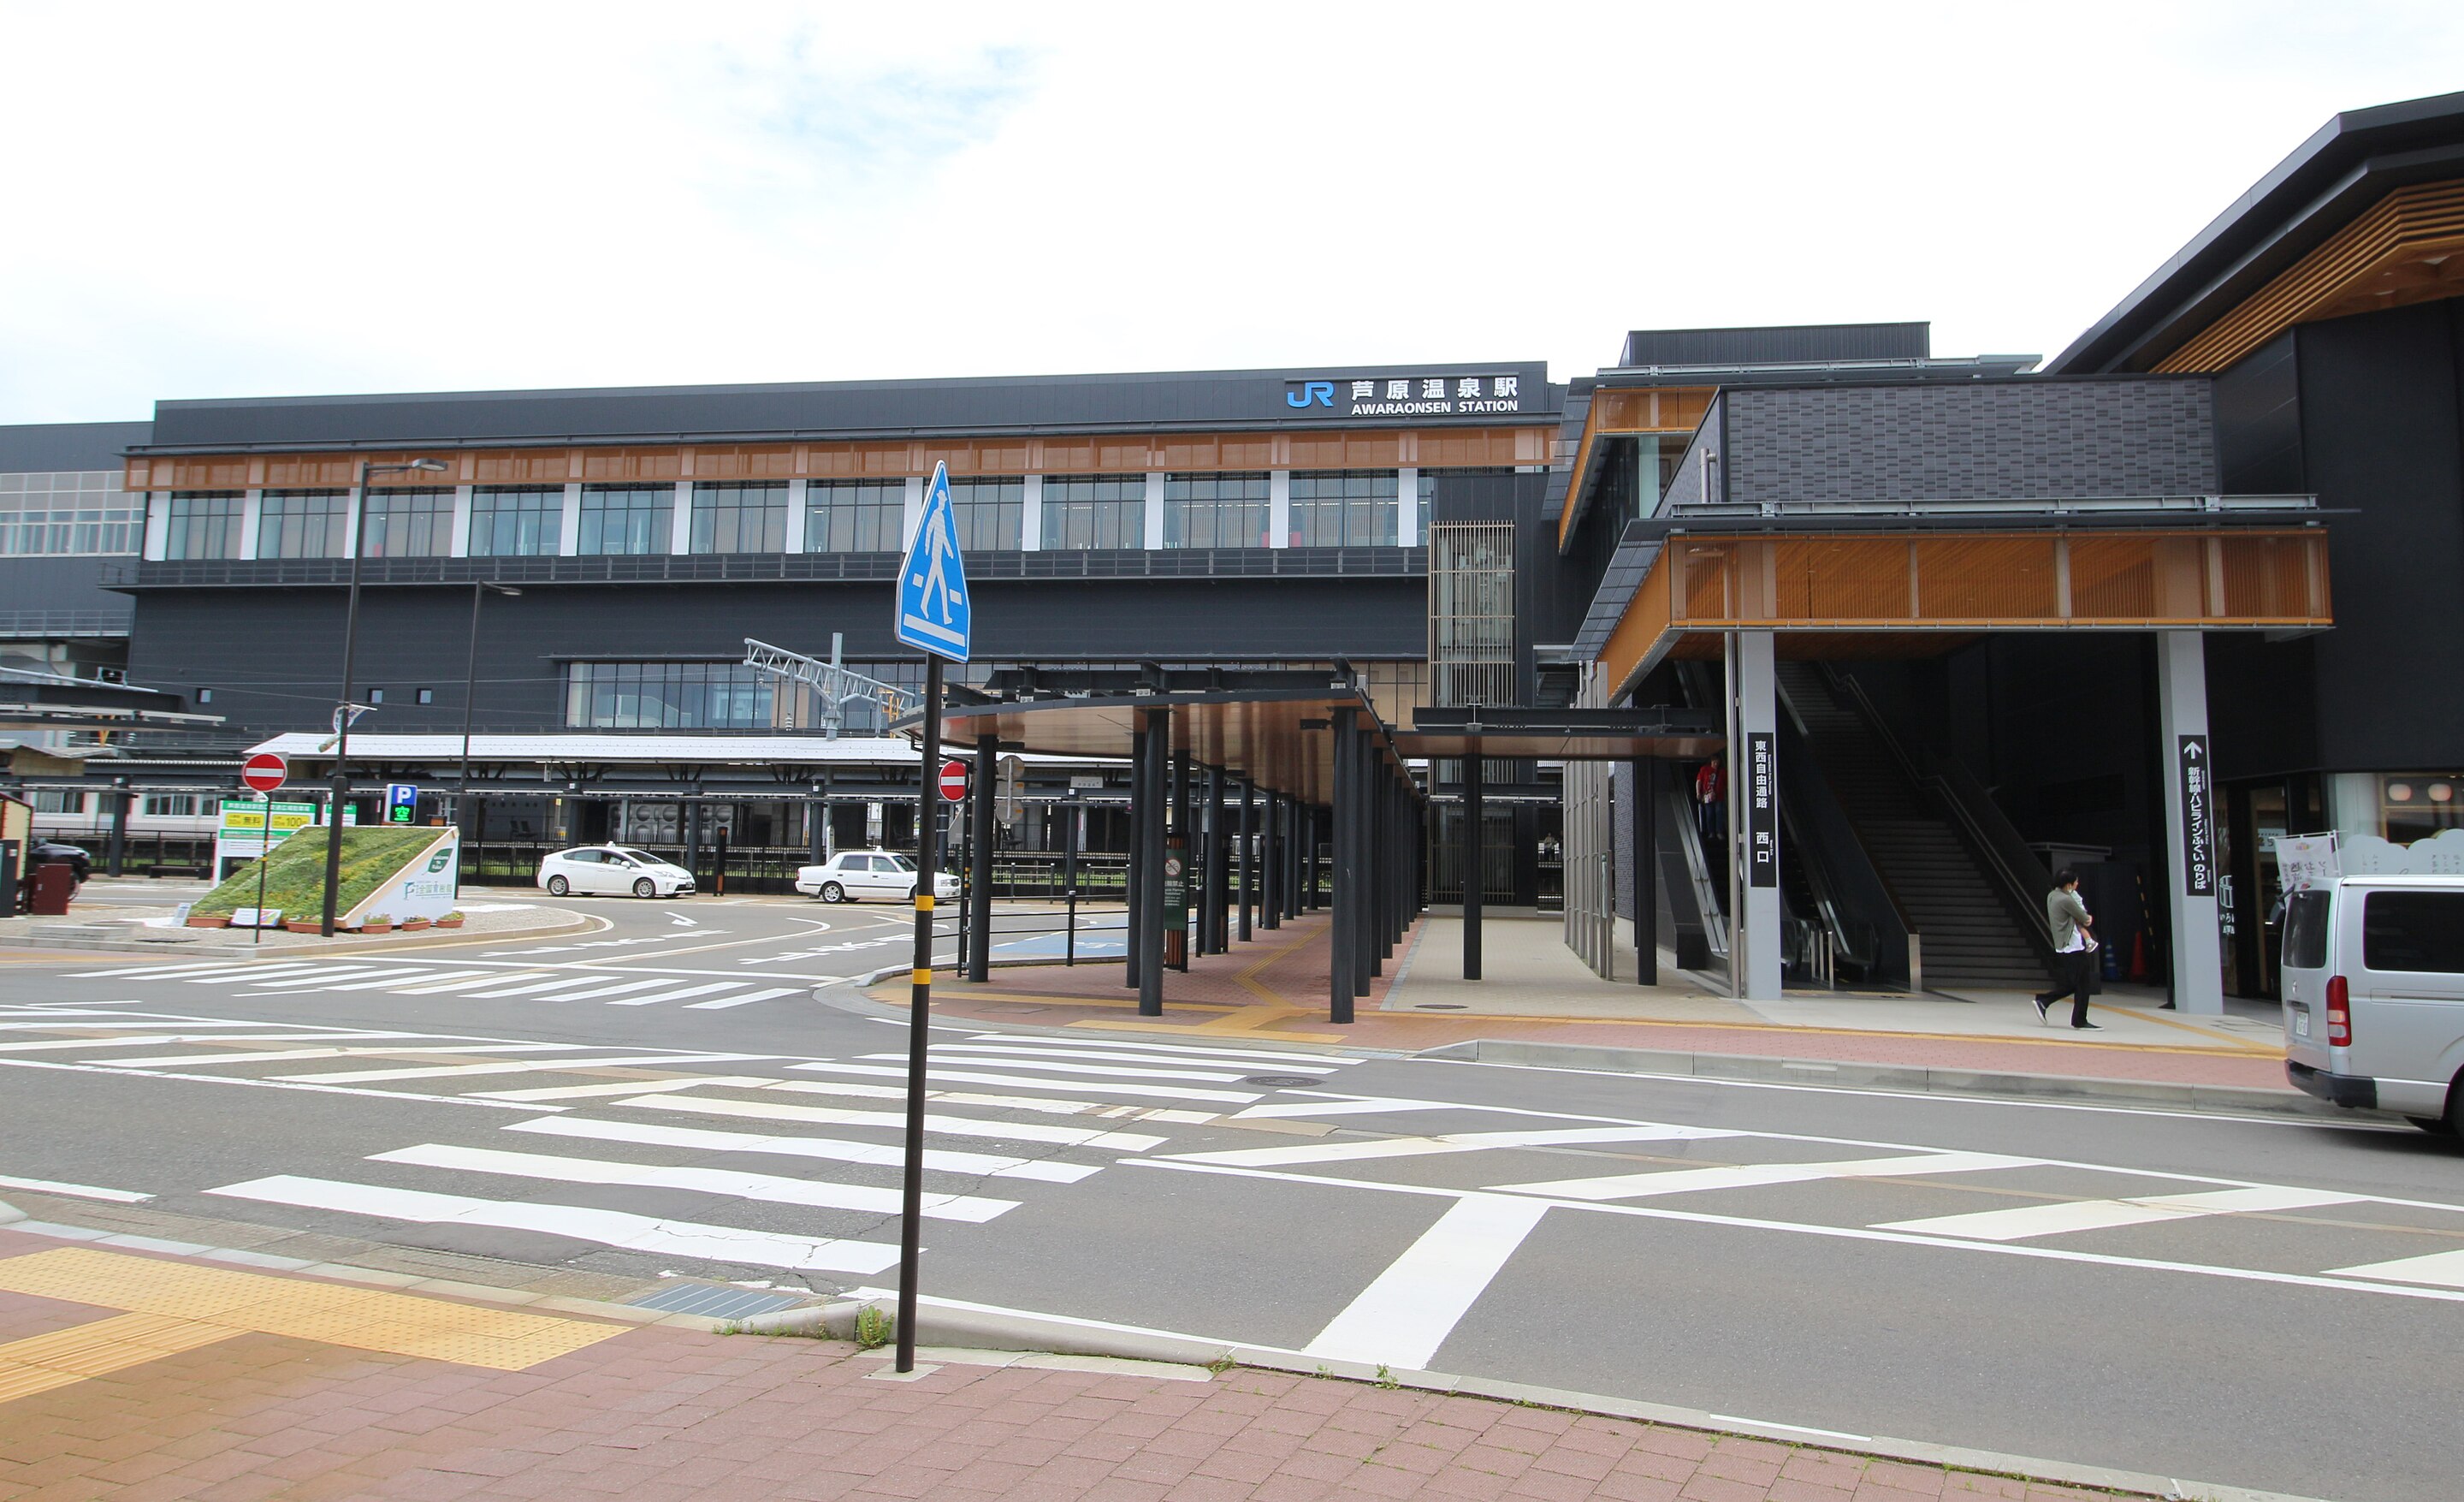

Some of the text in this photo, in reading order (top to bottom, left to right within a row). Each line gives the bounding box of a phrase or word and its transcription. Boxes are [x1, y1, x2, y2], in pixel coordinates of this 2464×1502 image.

[1287, 381, 1335, 408] JR
[1351, 377, 1518, 401] 芦原温泉駅
[1351, 400, 1519, 416] AWARAONSEN STATION
[1755, 740, 1768, 809] 東西自由通路
[397, 787, 412, 804] P
[394, 805, 411, 822] 空
[1756, 831, 1769, 864] 西口
